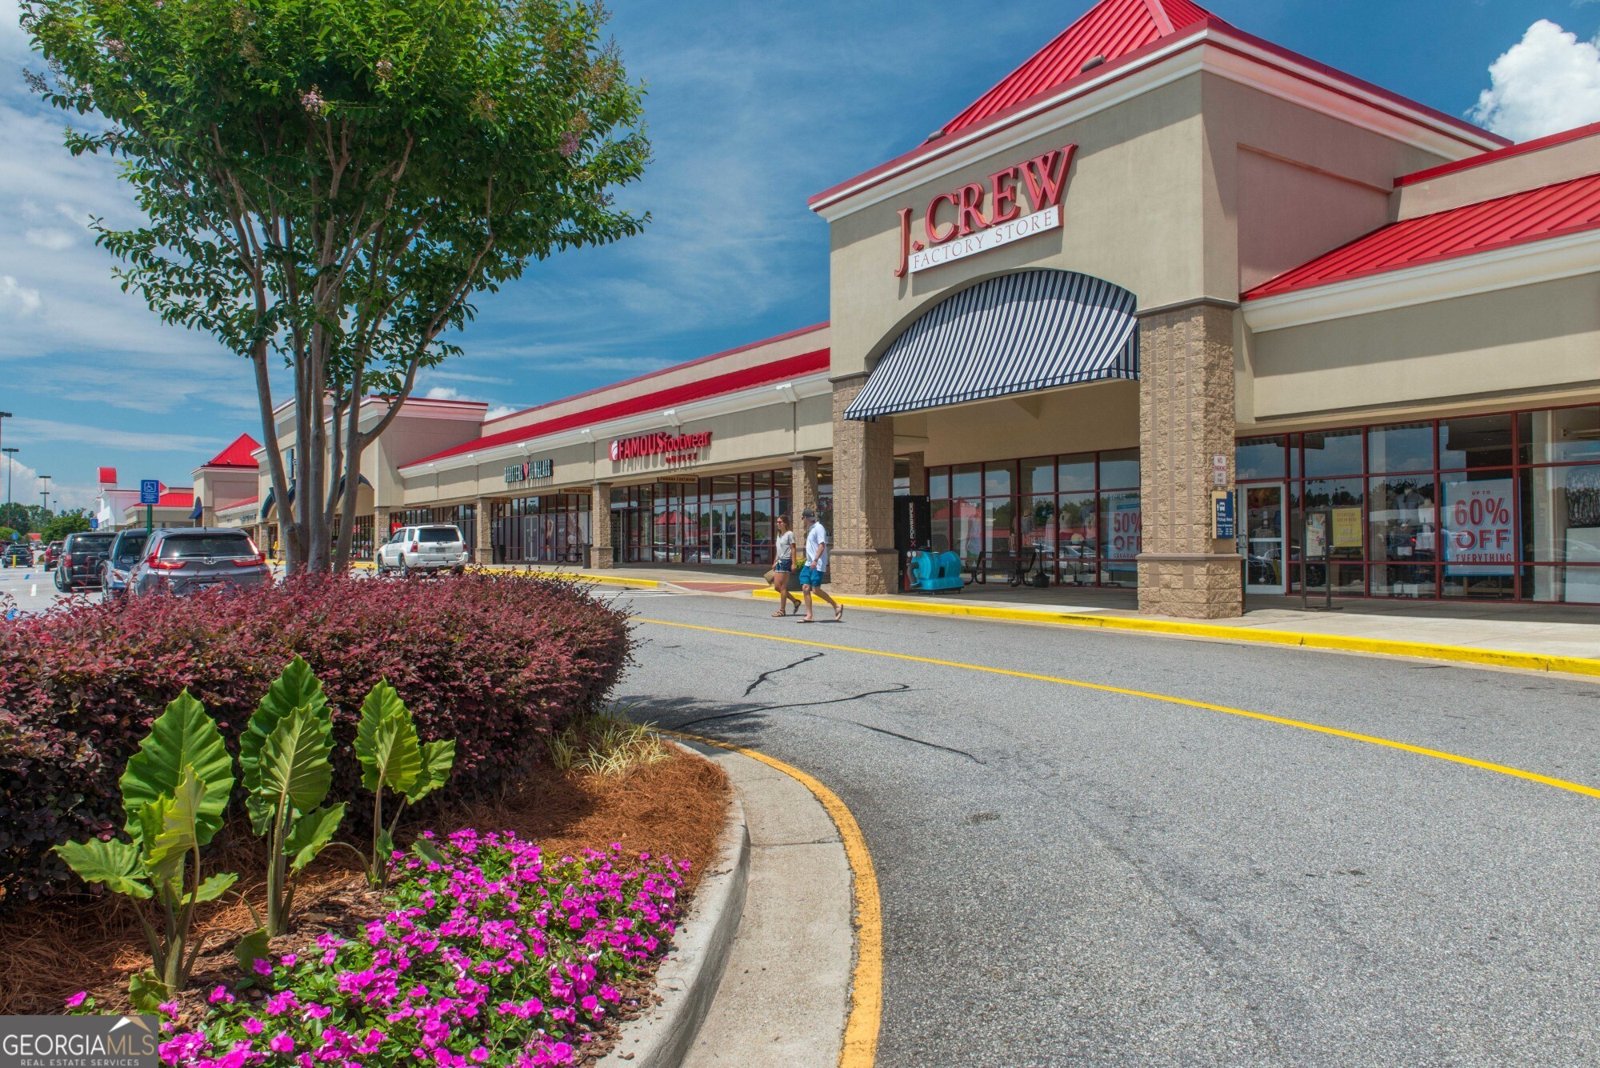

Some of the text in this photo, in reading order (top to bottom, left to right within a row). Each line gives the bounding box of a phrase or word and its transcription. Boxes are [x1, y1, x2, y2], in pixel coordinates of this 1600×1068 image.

[913, 210, 1053, 270] FACTORY STORE
[618, 432, 666, 460] FAMOUS
[1455, 498, 1509, 526] 60%
[1455, 529, 1509, 550] OFF
[1456, 553, 1512, 562] EVERYTHING
